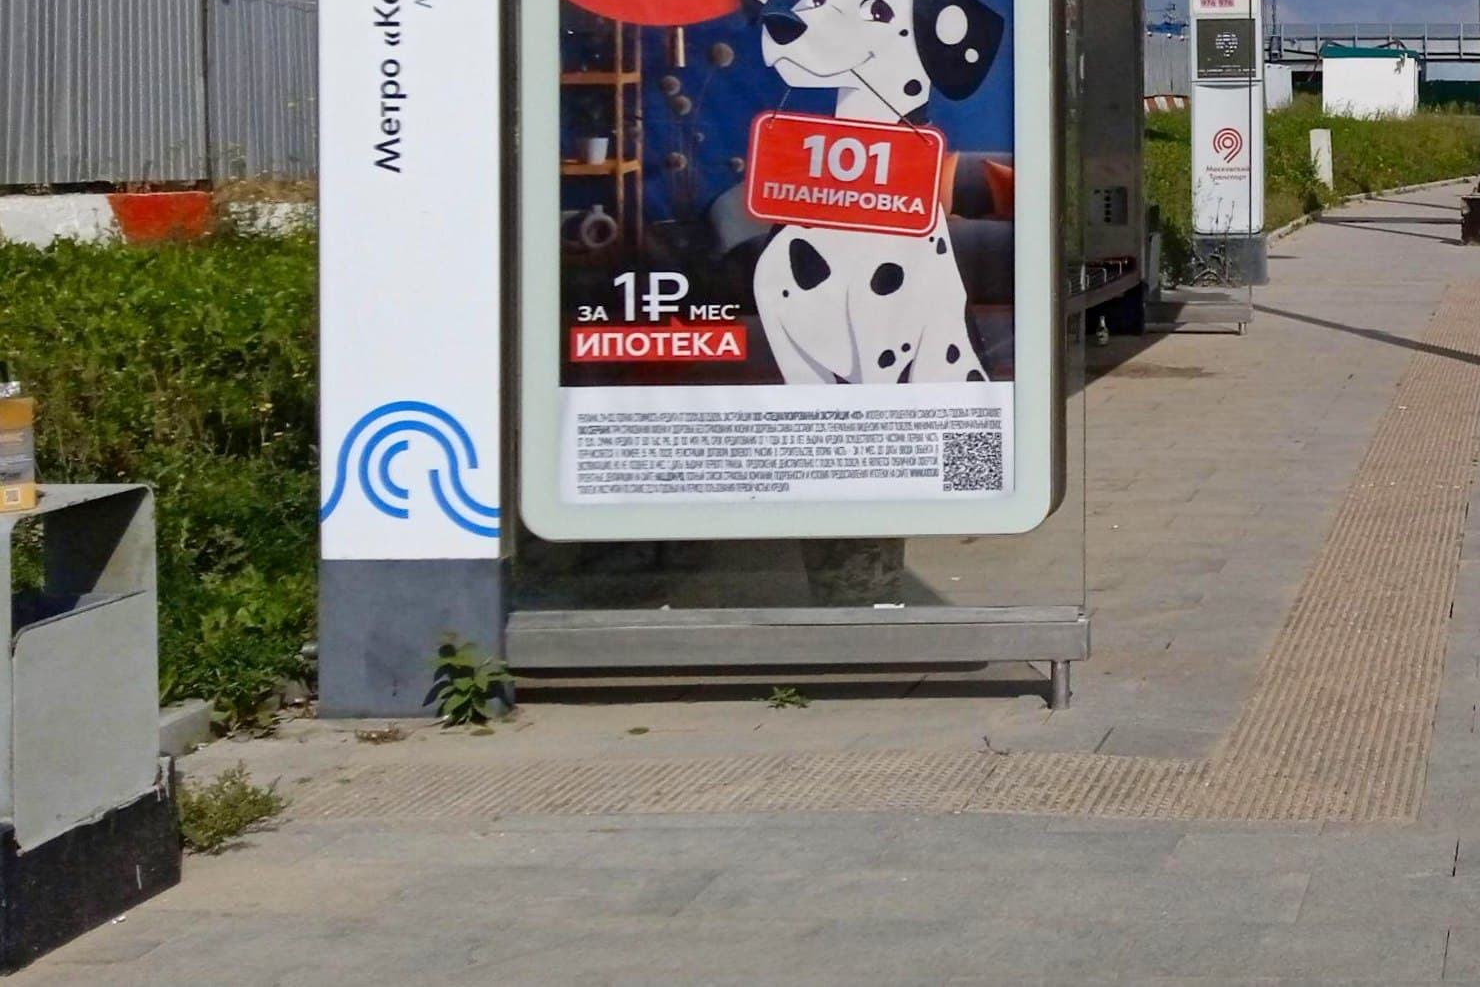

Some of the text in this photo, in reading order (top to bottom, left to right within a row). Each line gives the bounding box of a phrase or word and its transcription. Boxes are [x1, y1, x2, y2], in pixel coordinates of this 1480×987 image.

[372, 58, 408, 173] Метро
[802, 133, 892, 186] 101
[762, 181, 926, 215] ПЛАНИРОВКА
[576, 305, 609, 322] ЗА
[575, 331, 742, 357] ИПОТЕКА
